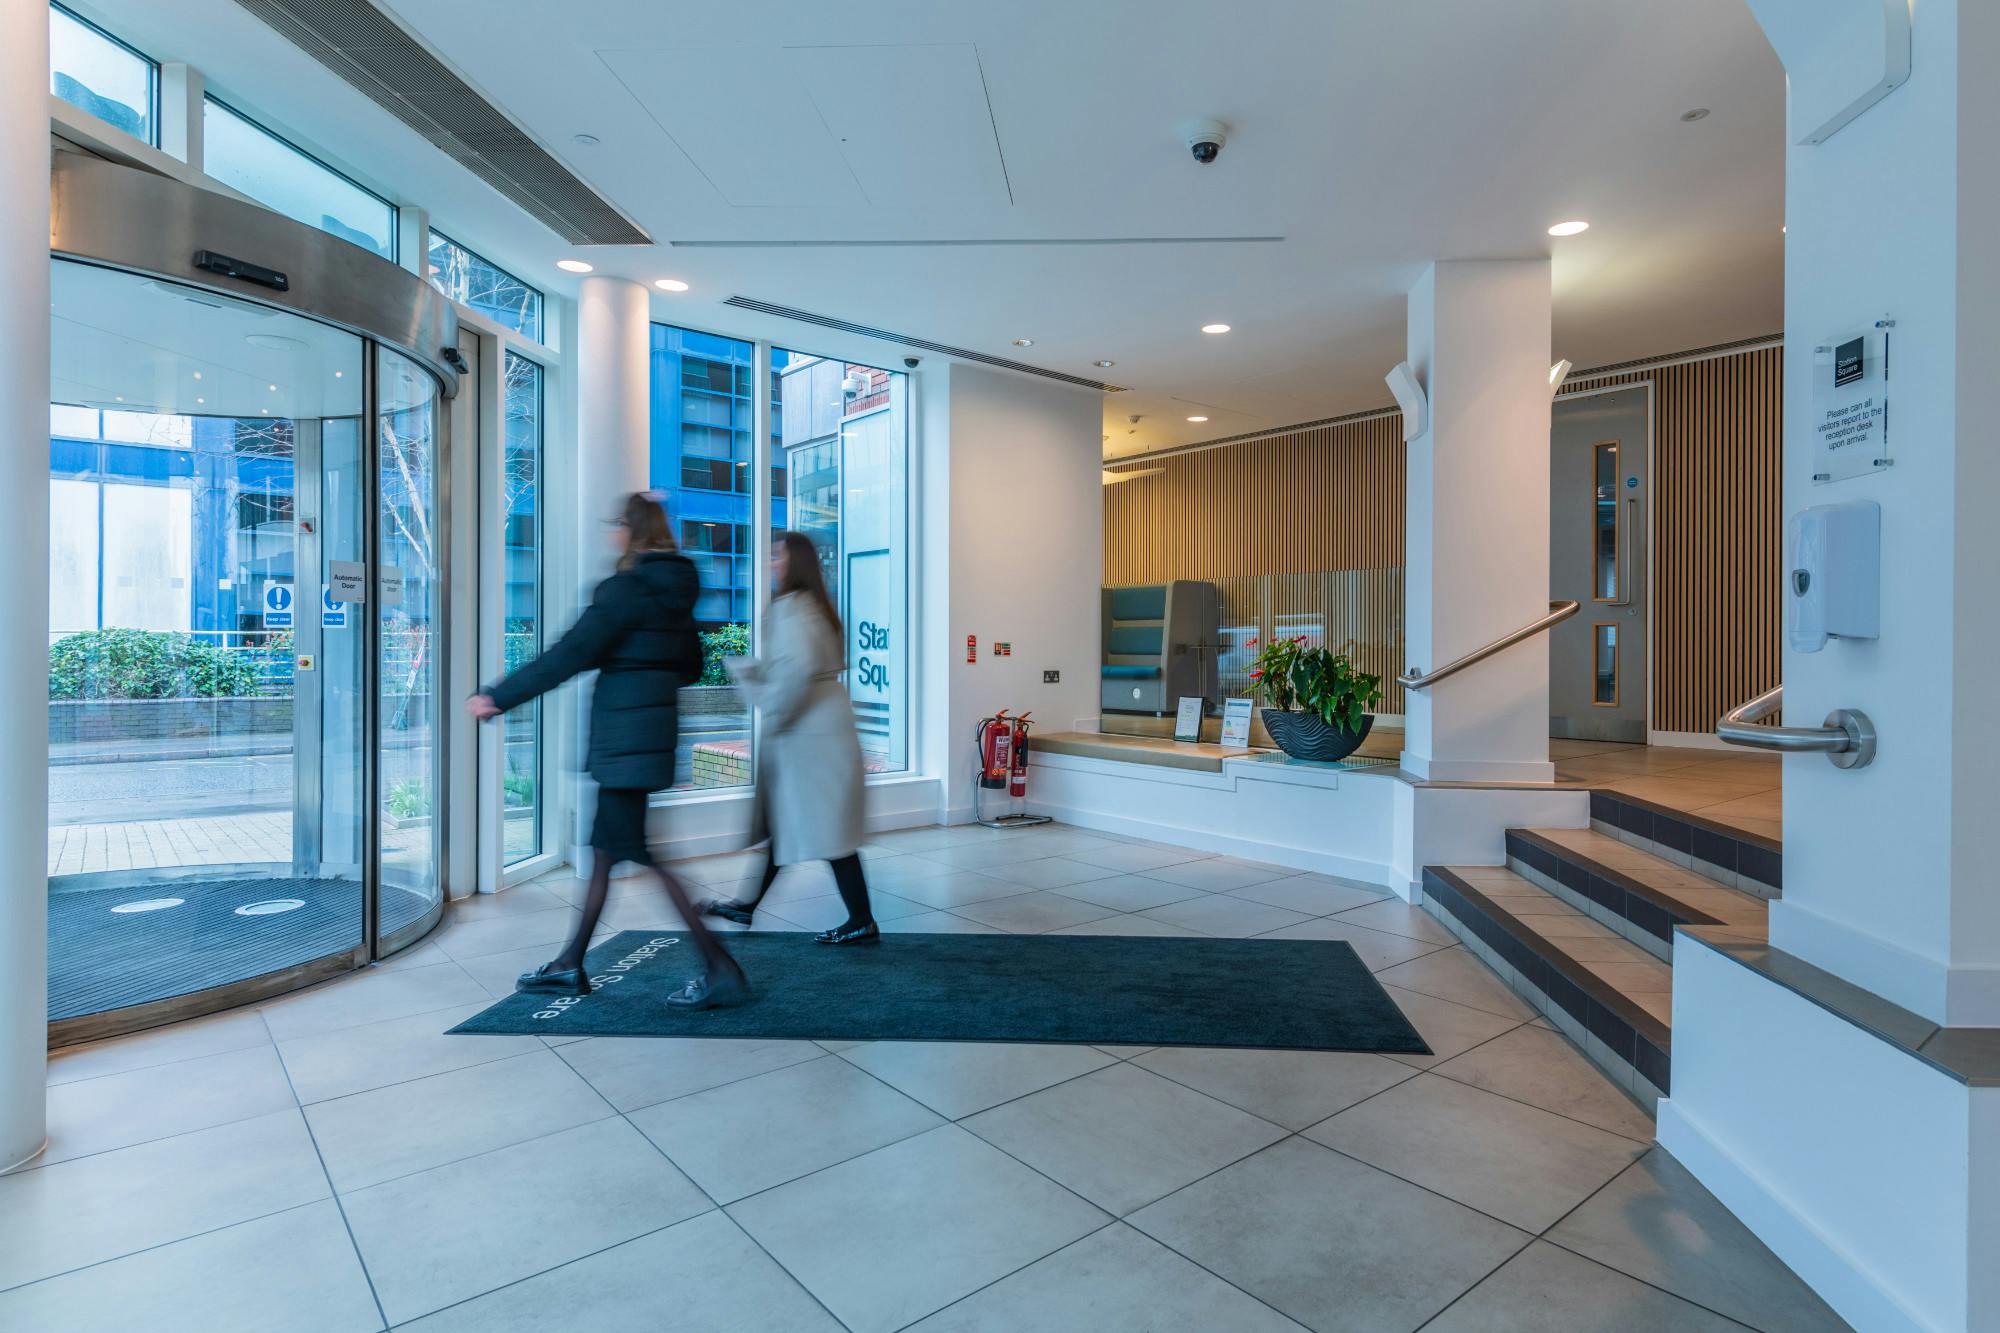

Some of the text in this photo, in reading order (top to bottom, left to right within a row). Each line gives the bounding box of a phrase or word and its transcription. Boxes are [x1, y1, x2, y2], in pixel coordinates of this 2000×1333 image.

[1837, 364, 1858, 377] Square
[1838, 357, 1857, 368] Station
[1827, 397, 1873, 420] Please can all
[1818, 406, 1882, 433] visitors report to the
[1825, 420, 1873, 441] reception desk
[1828, 439, 1845, 452] upon
[334, 574, 362, 582] Automatic
[858, 621, 889, 650] Sta
[604, 937, 679, 972] Station
